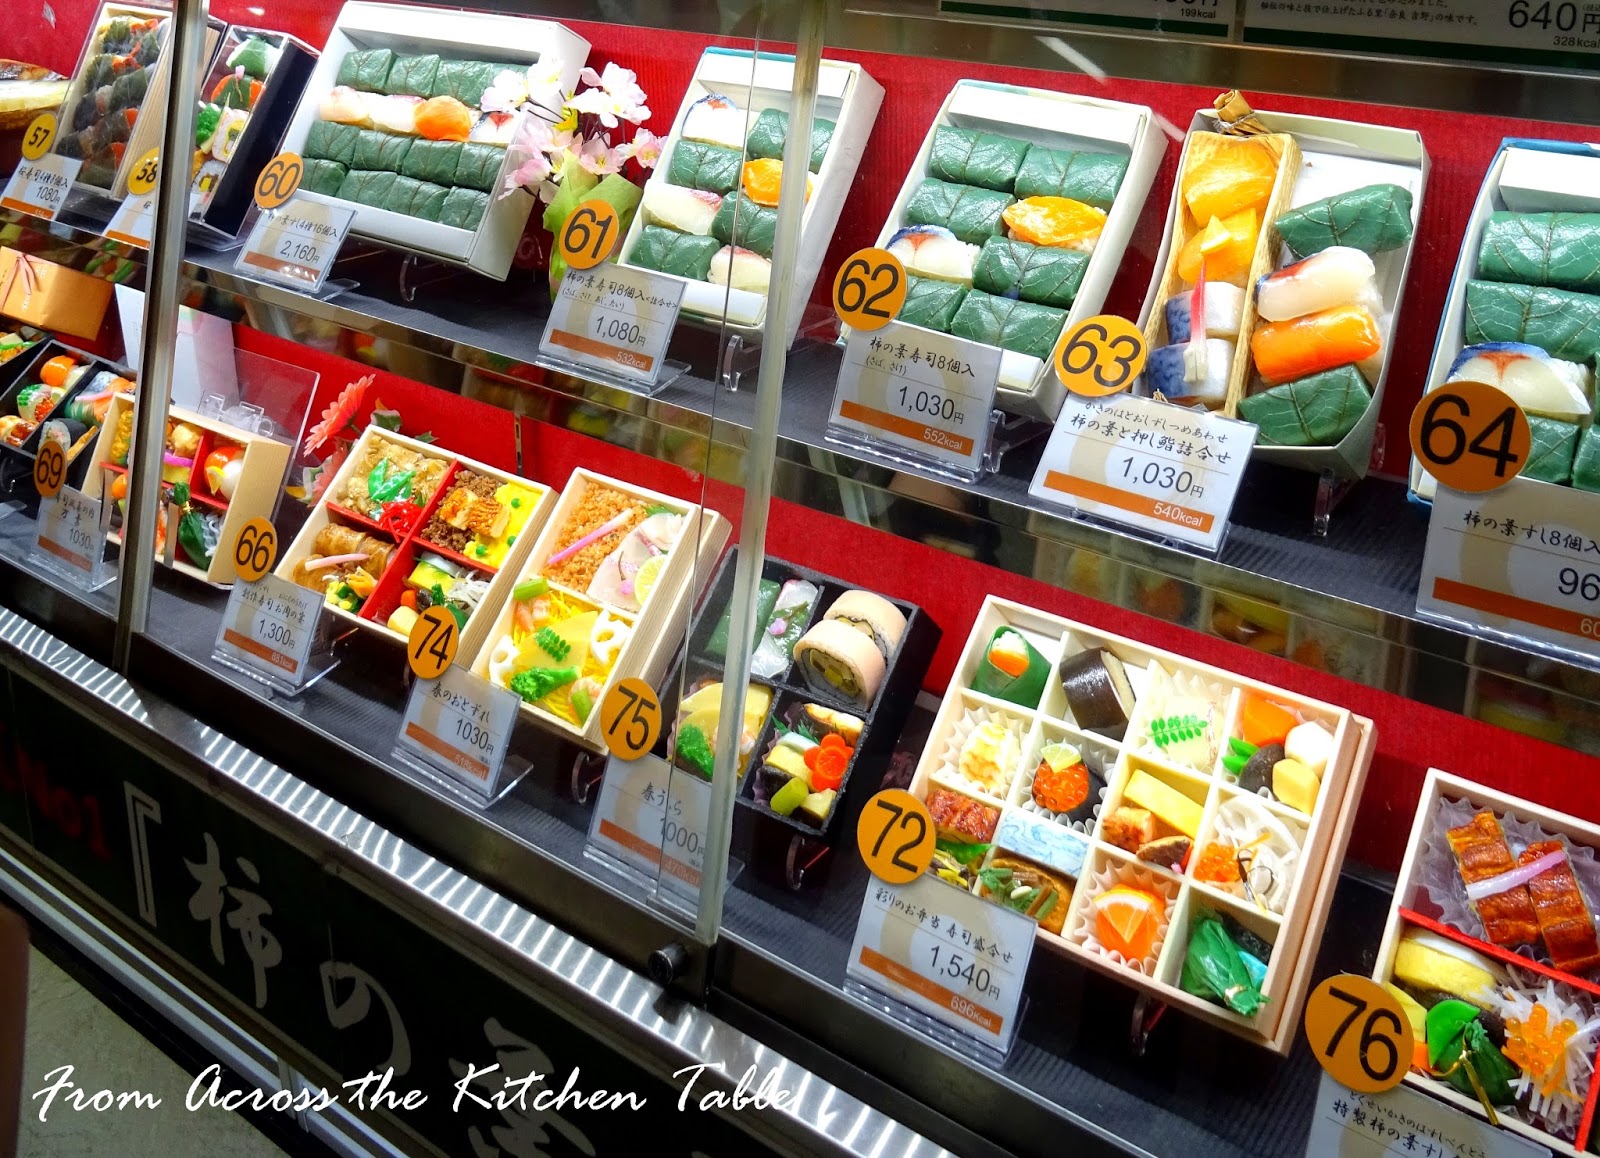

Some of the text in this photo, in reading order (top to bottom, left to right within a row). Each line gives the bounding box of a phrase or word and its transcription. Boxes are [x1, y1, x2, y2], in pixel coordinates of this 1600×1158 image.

[1180, 8, 1216, 19] 199kcal
[29, 127, 50, 148] 57
[136, 162, 158, 183] 58
[258, 161, 300, 199] 60
[564, 208, 612, 259] 61
[837, 258, 899, 319] 62
[596, 315, 646, 346] 1,080円
[616, 351, 646, 369] 532kcal
[869, 336, 975, 378] 柿の葉寿司8個入
[1062, 323, 1141, 387] 63
[899, 386, 964, 424] 1,030円
[924, 428, 962, 450] 552kcal
[1420, 393, 1518, 478] 64
[37, 448, 63, 488] 69
[1122, 456, 1204, 498] 1,030円
[1153, 503, 1203, 527] 540kcal
[1463, 509, 1600, 554] 柿の葉すし8個入
[236, 524, 273, 572] 66
[415, 613, 453, 670] 74
[432, 681, 490, 723] 春のおとずれ
[608, 685, 656, 751] 75
[871, 799, 927, 874] 72
[930, 945, 1000, 1001] 1,540円
[1325, 985, 1402, 1082] 76
[1332, 1098, 1462, 1158] 特製柿の葉すし
